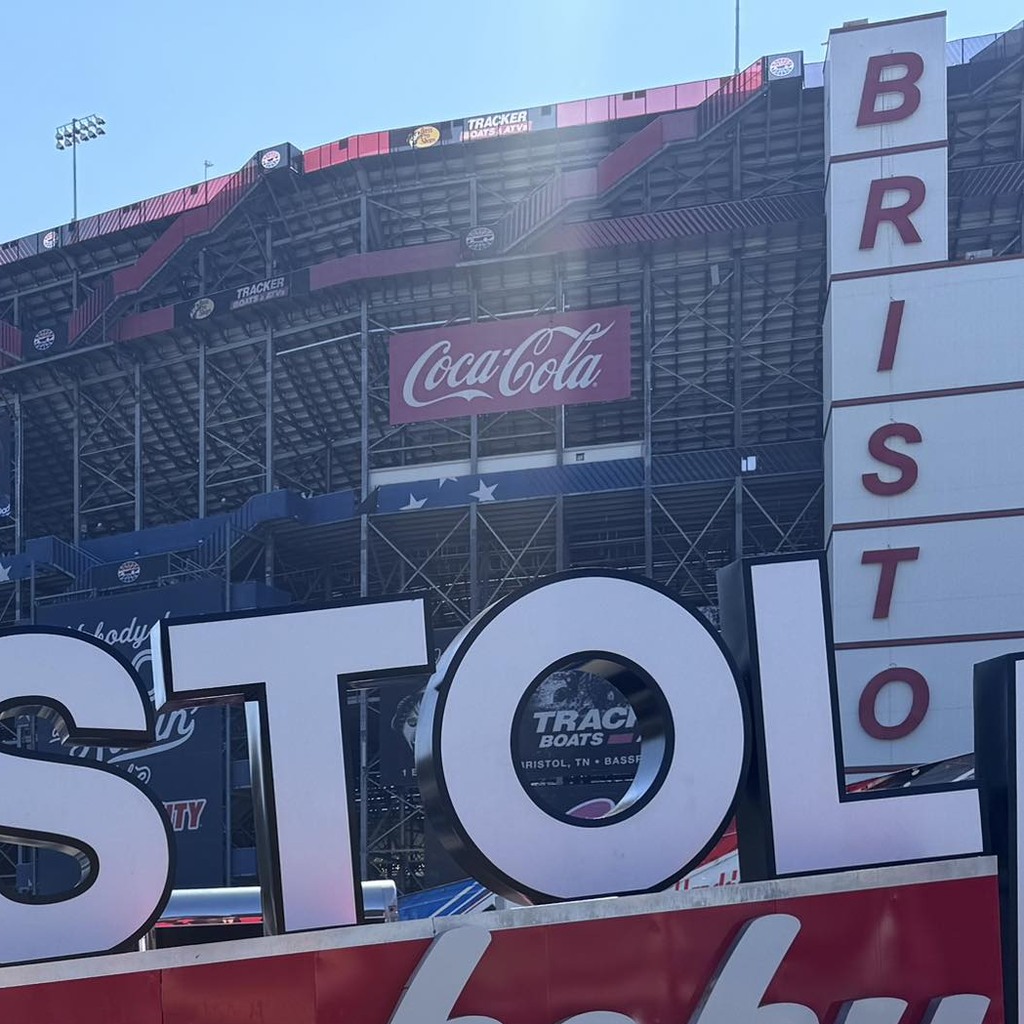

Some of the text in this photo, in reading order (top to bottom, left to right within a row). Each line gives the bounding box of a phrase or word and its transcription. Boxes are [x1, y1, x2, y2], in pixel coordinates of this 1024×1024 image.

[467, 111, 528, 130] TRACKER
[237, 277, 285, 299] TRACKER
[402, 320, 616, 408] Coca-Cola
[539, 732, 604, 748] BOATS
[521, 759, 571, 769] RISTOL,
[576, 758, 590, 767] TN
